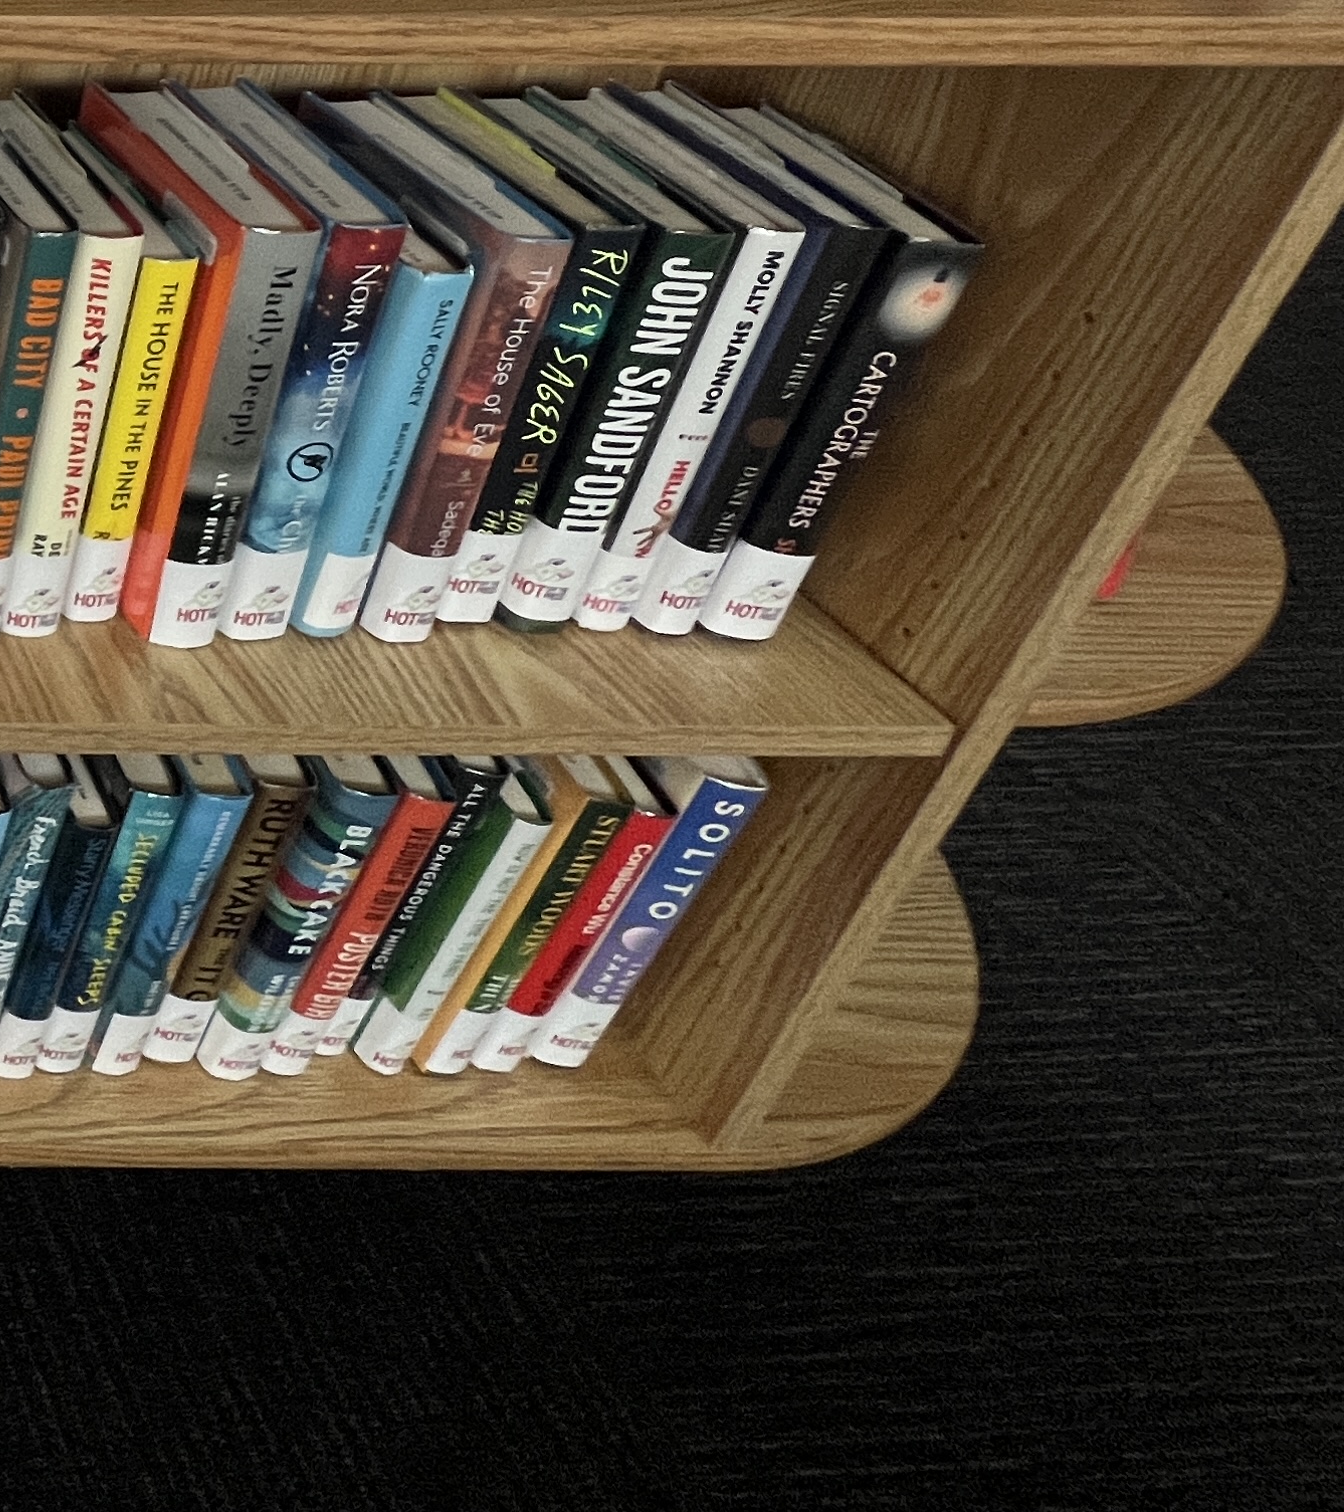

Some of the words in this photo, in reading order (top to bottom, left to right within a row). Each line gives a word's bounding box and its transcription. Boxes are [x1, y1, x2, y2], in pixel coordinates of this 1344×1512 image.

[25, 278, 62, 327] BAD
[83, 259, 112, 340] KILLERS
[157, 283, 179, 314] THE
[340, 264, 382, 333] NORA
[519, 266, 552, 309] The
[631, 257, 714, 355] JOHN
[744, 251, 783, 314] MOLLY
[429, 299, 452, 338] SALLY
[13, 338, 51, 388] CITY
[137, 323, 170, 392] HOUSE
[408, 342, 438, 406] ROONEY
[492, 318, 530, 385] House
[699, 321, 753, 414] SHANNON
[314, 341, 360, 431] ROBERTS
[482, 394, 502, 416] of
[66, 400, 93, 478] CERTAIN
[125, 422, 145, 454] THE
[466, 423, 493, 457] Eve
[560, 366, 671, 533] SANDFORD
[788, 351, 896, 530] CARTOGRAPHERS
[61, 484, 79, 519] AGE
[111, 460, 138, 511] PINES
[243, 799, 292, 867] RUTH
[318, 824, 371, 894] BLACK
[649, 801, 744, 921] SOLITO
[213, 875, 263, 939] WARE
[399, 844, 452, 920] DANGEROUS
[288, 899, 333, 955] CAKE
[372, 927, 405, 970] THINGS
